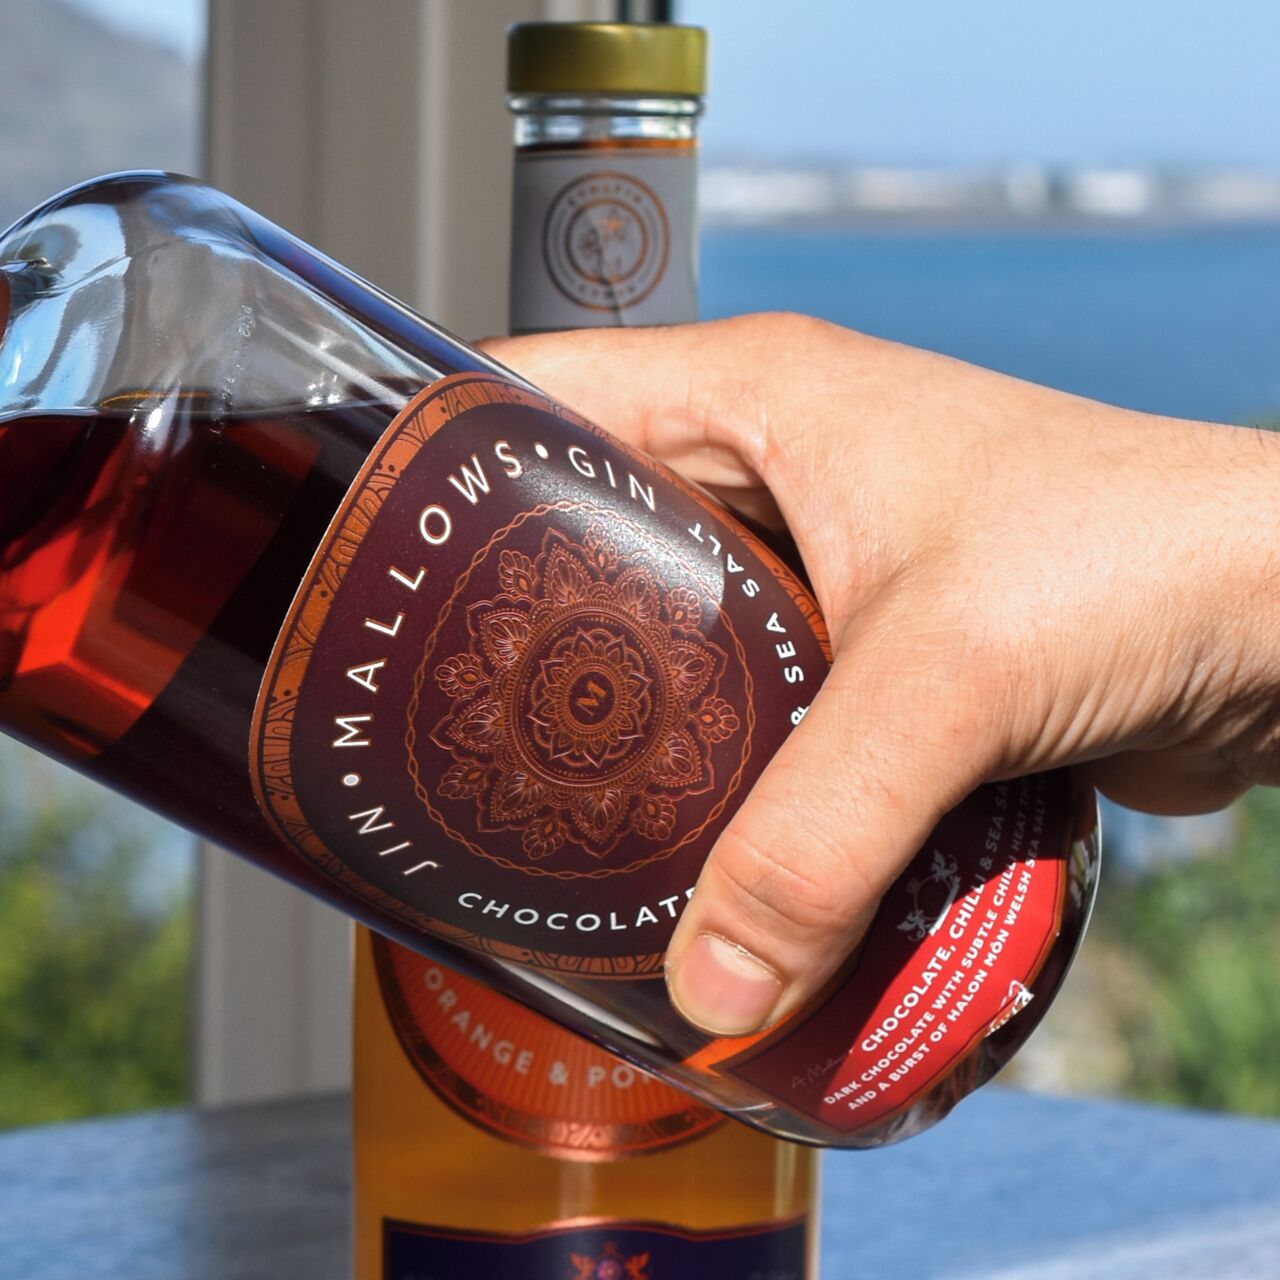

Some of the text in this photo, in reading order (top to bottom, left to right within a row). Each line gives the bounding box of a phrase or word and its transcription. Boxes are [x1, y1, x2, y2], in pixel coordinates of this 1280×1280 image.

[688, 523, 761, 598] SALT
[332, 440, 658, 876] JIN MALLOWS GIN
[766, 612, 805, 683] SEA
[979, 856, 993, 871] &
[985, 816, 1004, 853] SEA
[949, 873, 986, 939] CHILLI
[824, 1081, 862, 1105] DARK
[861, 1011, 935, 1081] CHOCOLATE
[932, 970, 965, 1009] WITH
[961, 909, 998, 968] SUBTLE
[848, 1090, 877, 1110] AND
[878, 1081, 891, 1091] A
[888, 1043, 931, 1081] BURST
[930, 1022, 948, 1043] OF
[947, 969, 988, 1022] HALON
[983, 928, 1010, 967] MÔN
[1003, 870, 1032, 925] WELSH
[1024, 839, 1040, 869] SEA
[861, 946, 957, 1052] CHOCOLATE,
[424, 968, 534, 1076] ORANGE
[548, 1060, 568, 1086] &
